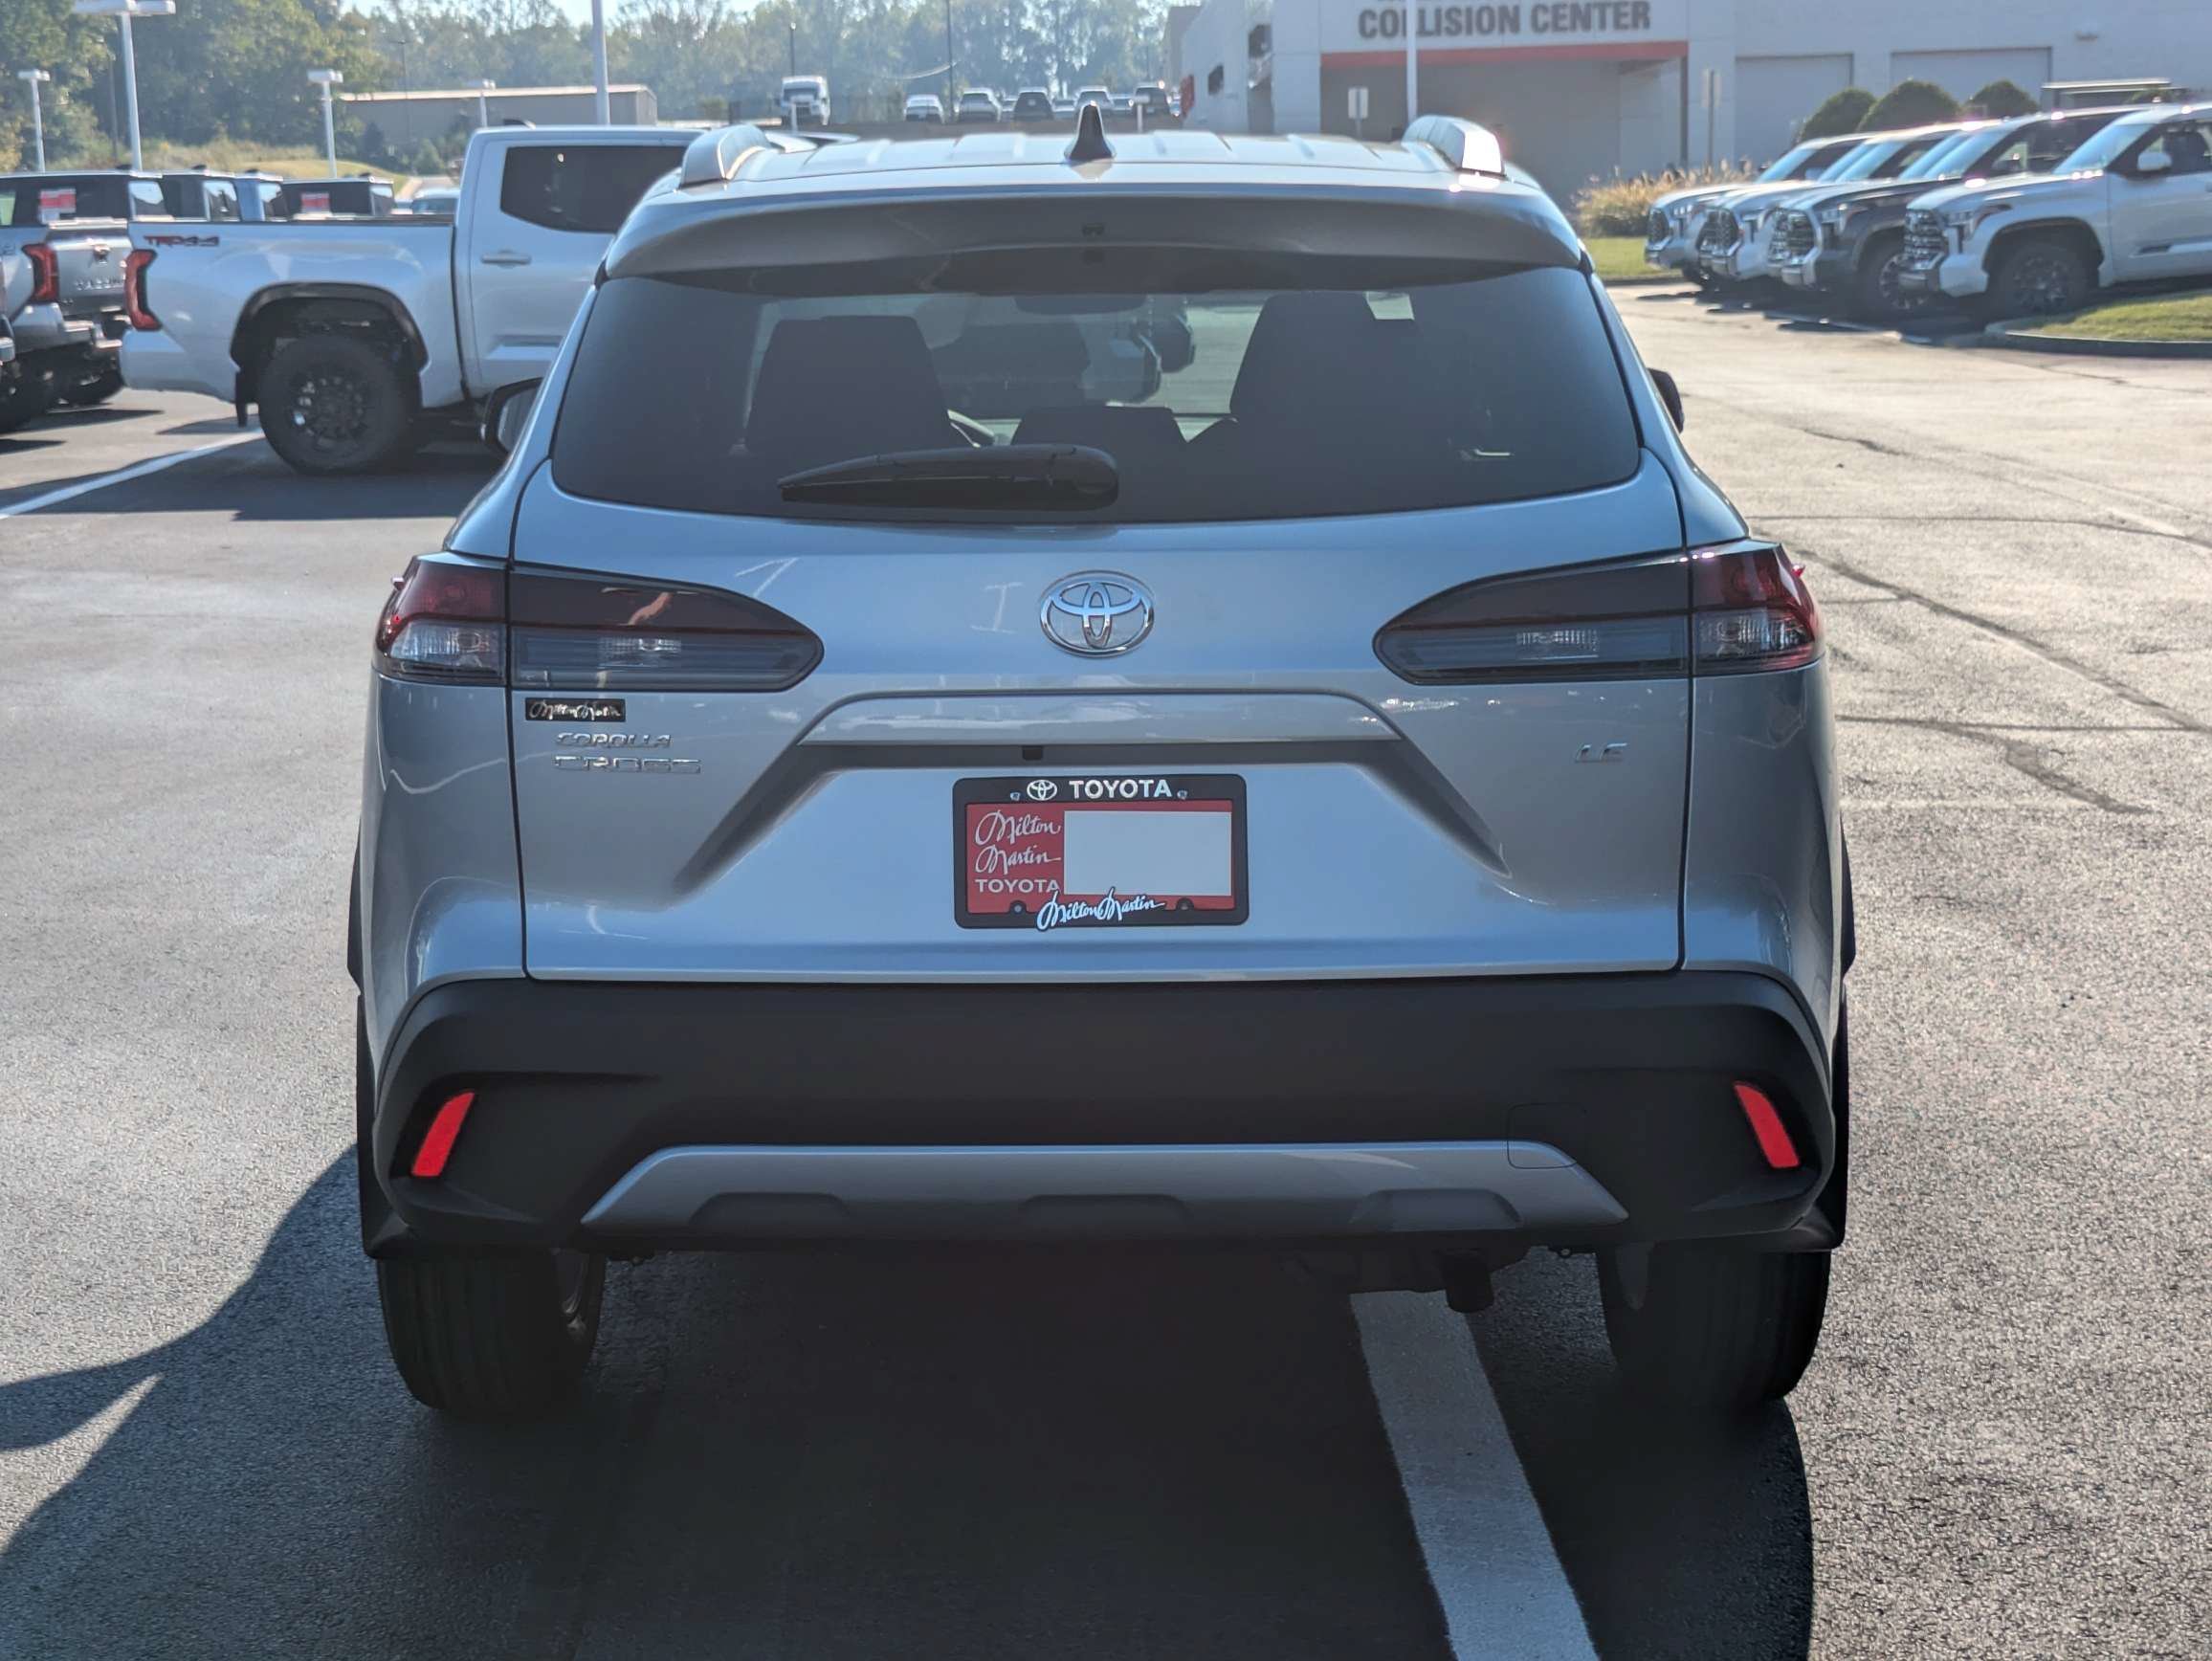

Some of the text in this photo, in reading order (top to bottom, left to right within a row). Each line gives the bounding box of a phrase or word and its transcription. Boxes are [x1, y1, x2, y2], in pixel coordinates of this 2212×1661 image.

[1531, 1, 1650, 33] CENTER
[1069, 779, 1172, 799] TOYOTA
[975, 809, 1061, 845] Milton
[975, 844, 1061, 875] Martin
[975, 878, 1060, 893] TOYOTA
[1036, 887, 1165, 930] Milton Martin
